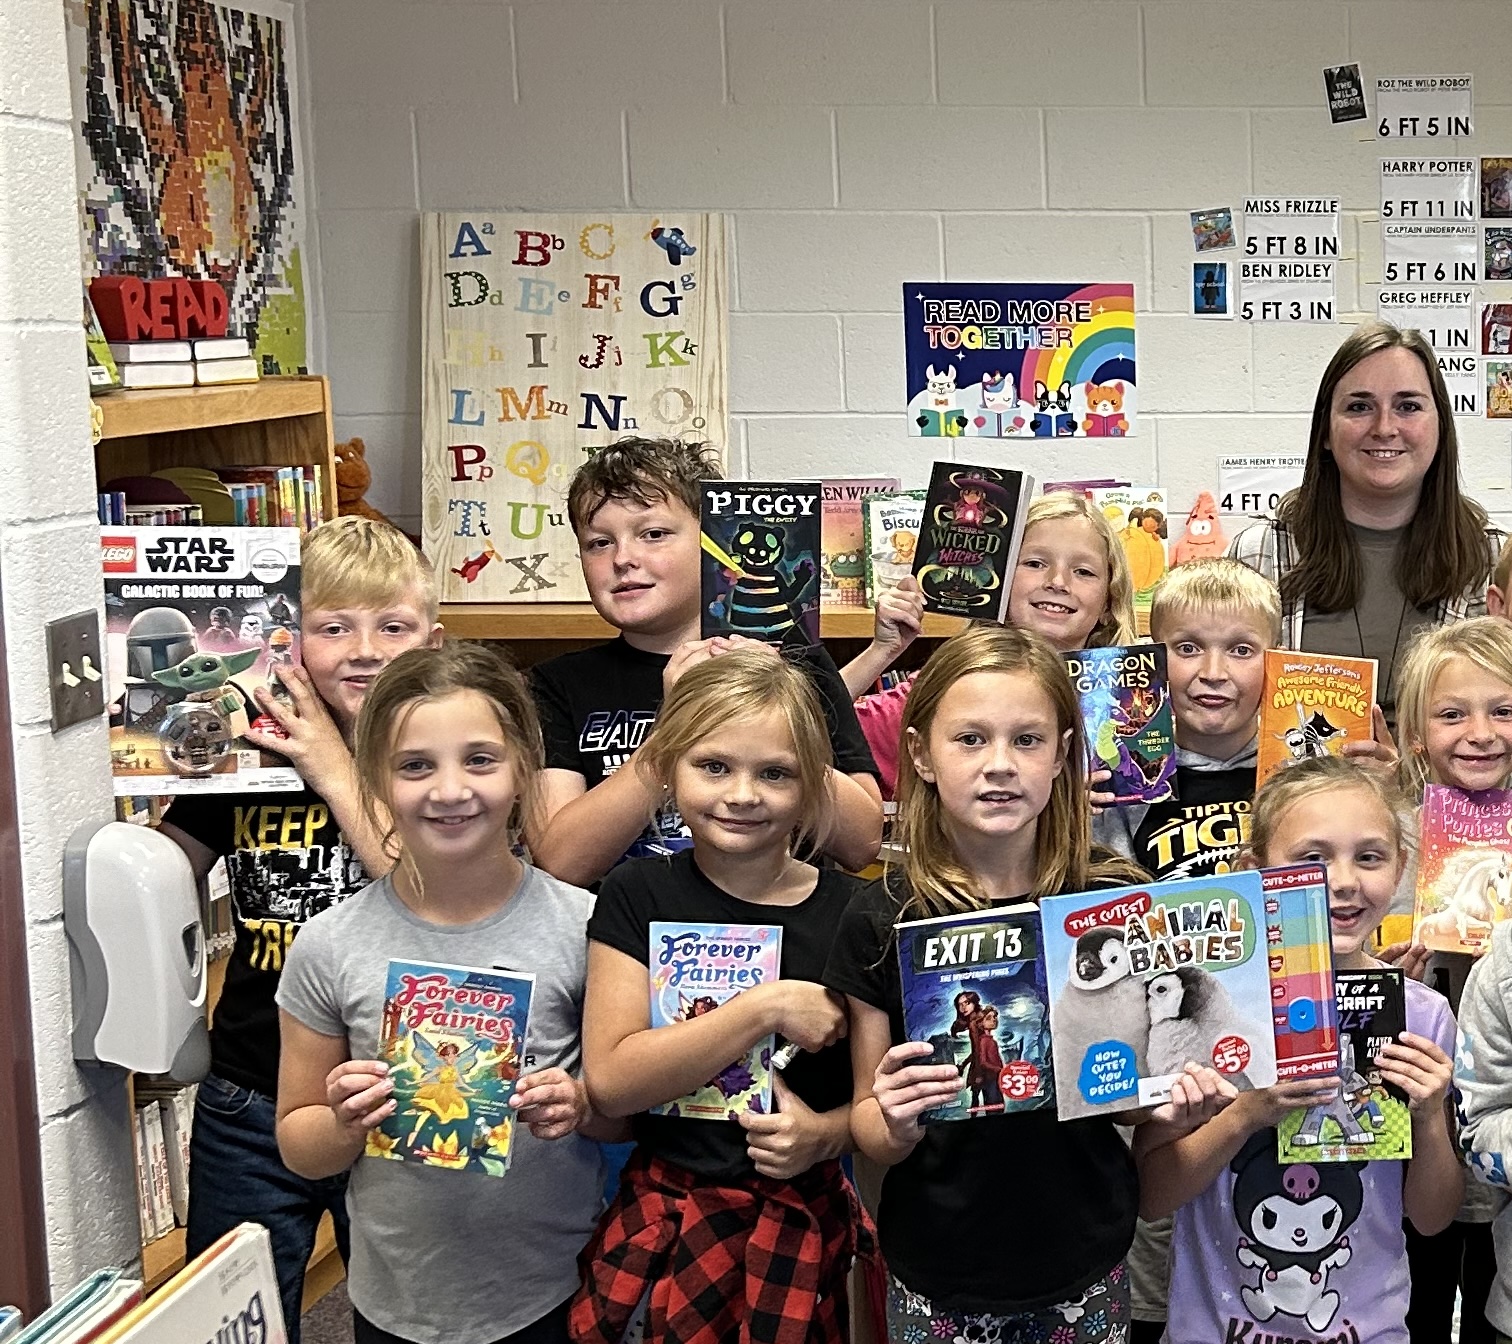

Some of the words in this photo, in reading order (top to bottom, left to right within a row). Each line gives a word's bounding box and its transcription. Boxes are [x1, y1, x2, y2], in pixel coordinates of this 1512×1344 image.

[1377, 79, 1395, 88] ROZ
[1398, 79, 1413, 88] THE
[1415, 78, 1437, 87] WILD
[1439, 78, 1470, 87] ROBOT
[1331, 97, 1361, 109] ROBOT
[1333, 89, 1358, 100] WILD
[1378, 118, 1390, 136] 6
[1399, 117, 1419, 136] FT
[1426, 117, 1439, 136] 5
[1447, 117, 1469, 136] IN
[1382, 161, 1424, 173] HARRY
[1429, 161, 1474, 172] POTTER
[1245, 200, 1280, 213] MISS
[1285, 200, 1338, 213] FRIZZLE
[1383, 201, 1393, 217] 5
[1400, 201, 1418, 216] FT
[1426, 201, 1444, 216] 11
[1454, 201, 1473, 216] IN
[1386, 226, 1422, 234] CAPTAIN
[1424, 226, 1476, 234] UNDERPANTS
[1245, 236, 1258, 255] 5
[1266, 236, 1287, 255] FT
[1294, 236, 1307, 255] 8
[1315, 236, 1337, 255] IN
[1242, 264, 1272, 277] BEN
[1278, 264, 1332, 277] RIDLEY
[1385, 263, 1398, 281] 5
[1406, 263, 1427, 281] FT
[1434, 263, 1445, 281] 6
[1454, 263, 1476, 281] IN
[1379, 292, 1416, 304] GREG
[1421, 292, 1471, 303] HEFFLEY
[119, 276, 229, 340] READ
[923, 299, 1001, 324] READ
[1008, 299, 1093, 324] MORE
[1241, 302, 1253, 320] 5
[1262, 302, 1282, 320] FT
[1289, 302, 1301, 320] 3
[1310, 301, 1332, 320] IN
[923, 325, 1074, 350] TOGETHER
[1447, 329, 1469, 346] IN
[1454, 394, 1476, 412] IN
[1221, 458, 1248, 466] JAMES
[1249, 458, 1276, 466] HENRY
[706, 491, 818, 517] PIGGY
[1221, 493, 1233, 511] 4
[1241, 493, 1262, 511] FT
[145, 536, 234, 555] STAR
[930, 528, 1001, 554] WICKED
[145, 555, 234, 573] WARS
[937, 548, 985, 565] WITCHES
[121, 584, 180, 599] GALACTIC
[182, 584, 216, 598] BOOK
[218, 584, 234, 598] OF
[235, 584, 264, 598] FUN!
[1065, 652, 1156, 677] DRAGON
[1076, 671, 1150, 693] GAMES
[1277, 676, 1324, 689] Awesome
[1325, 676, 1367, 697] Friendly
[1273, 688, 1368, 718] ADVENTURE
[234, 804, 329, 851] KEEP
[1442, 813, 1503, 838] Ponies
[1262, 871, 1324, 887] CUTE-O-METER
[1068, 913, 1096, 931] THE
[1099, 897, 1146, 924] CUTEST
[1124, 899, 1245, 947] ANIMAL
[659, 932, 762, 966] Forever
[923, 931, 986, 968] EXIT
[992, 927, 1023, 959] 13
[1129, 936, 1243, 976] BABIES
[669, 958, 763, 990] Fairies
[397, 973, 516, 1012] Forever
[1351, 984, 1366, 994] OF
[1369, 983, 1379, 994] A
[406, 1001, 515, 1042] Fairies
[1094, 1050, 1120, 1063] HOW
[1091, 1058, 1127, 1075] CUTE?
[1277, 1059, 1338, 1077] CUTE-O-METER
[1098, 1071, 1121, 1083] YOU
[1089, 1077, 1135, 1097] DECIDE!
